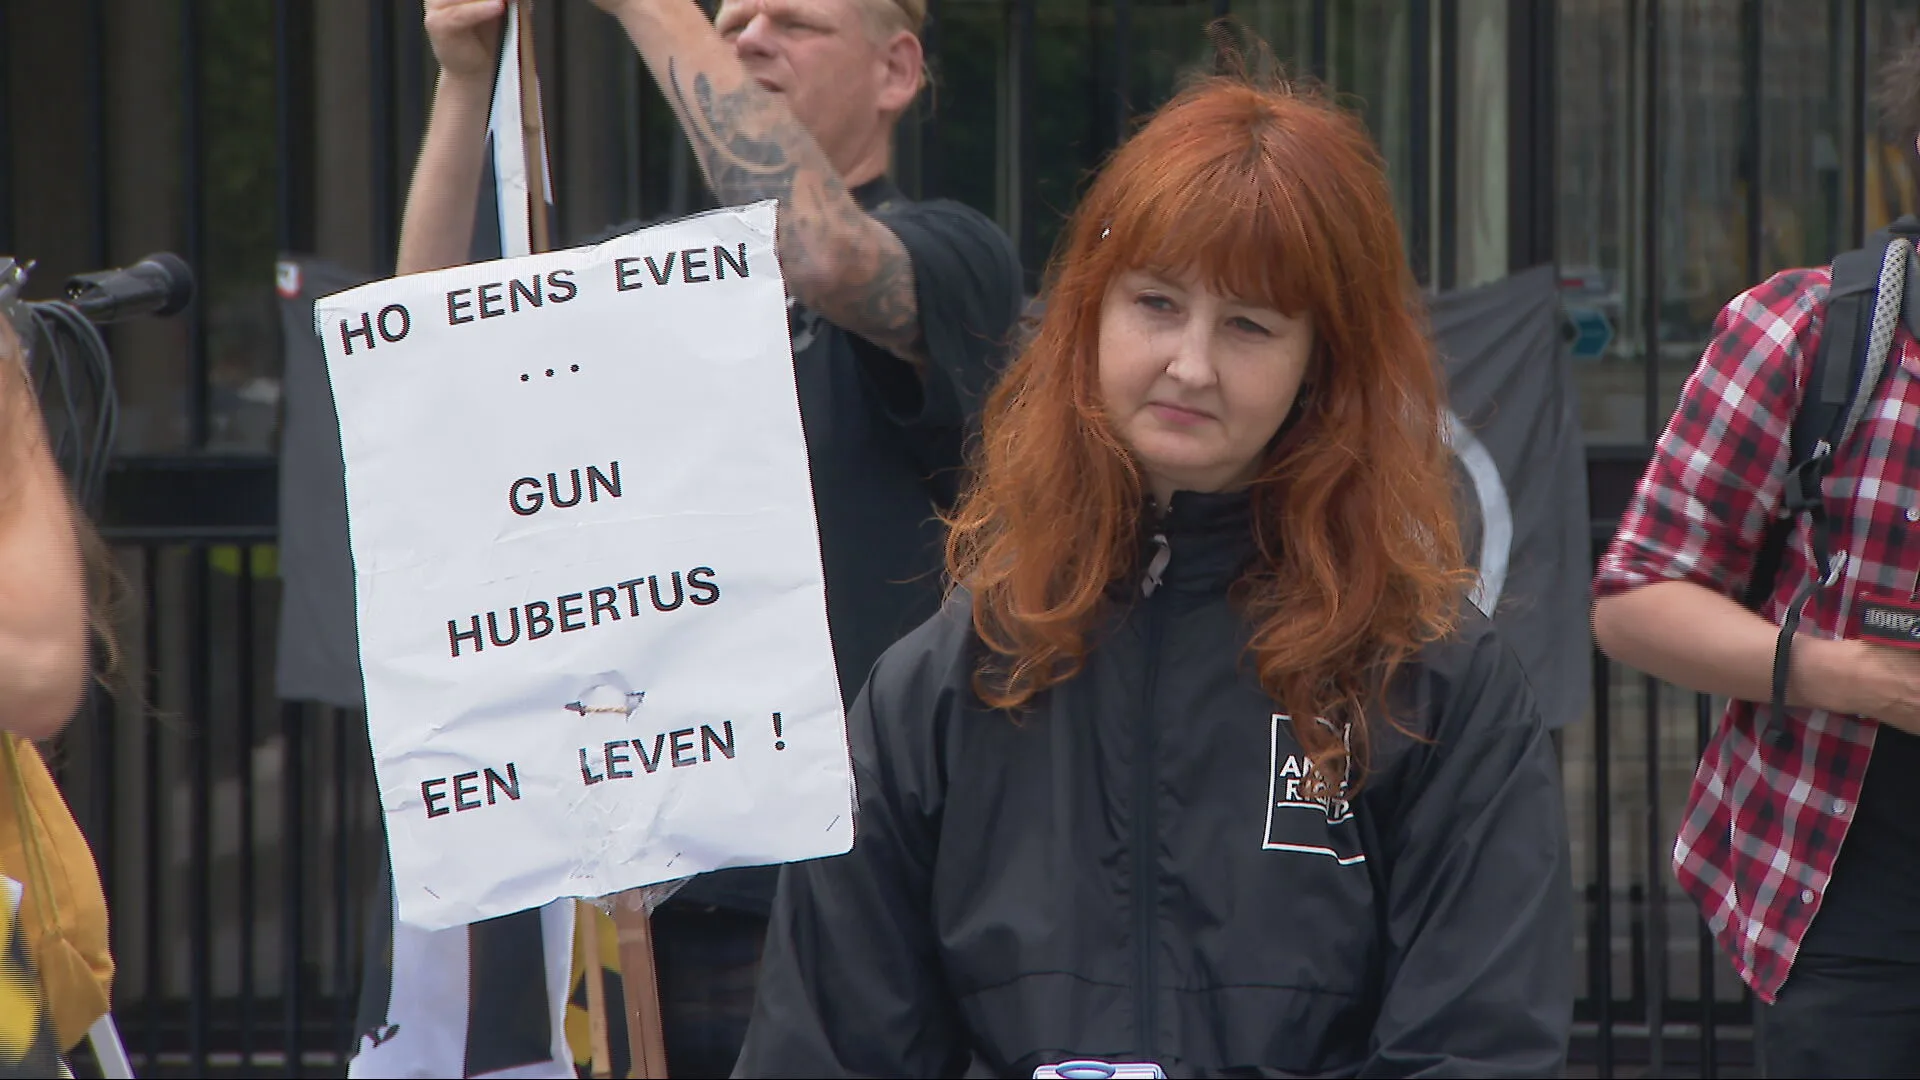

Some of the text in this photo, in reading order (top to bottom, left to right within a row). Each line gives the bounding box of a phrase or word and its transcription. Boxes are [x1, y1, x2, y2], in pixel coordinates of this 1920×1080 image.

[339, 242, 750, 356] HO EENS EVEN
[508, 460, 623, 516] GUN
[447, 566, 721, 658] HUBERTUS
[420, 711, 787, 819] EEN LEVEN !
